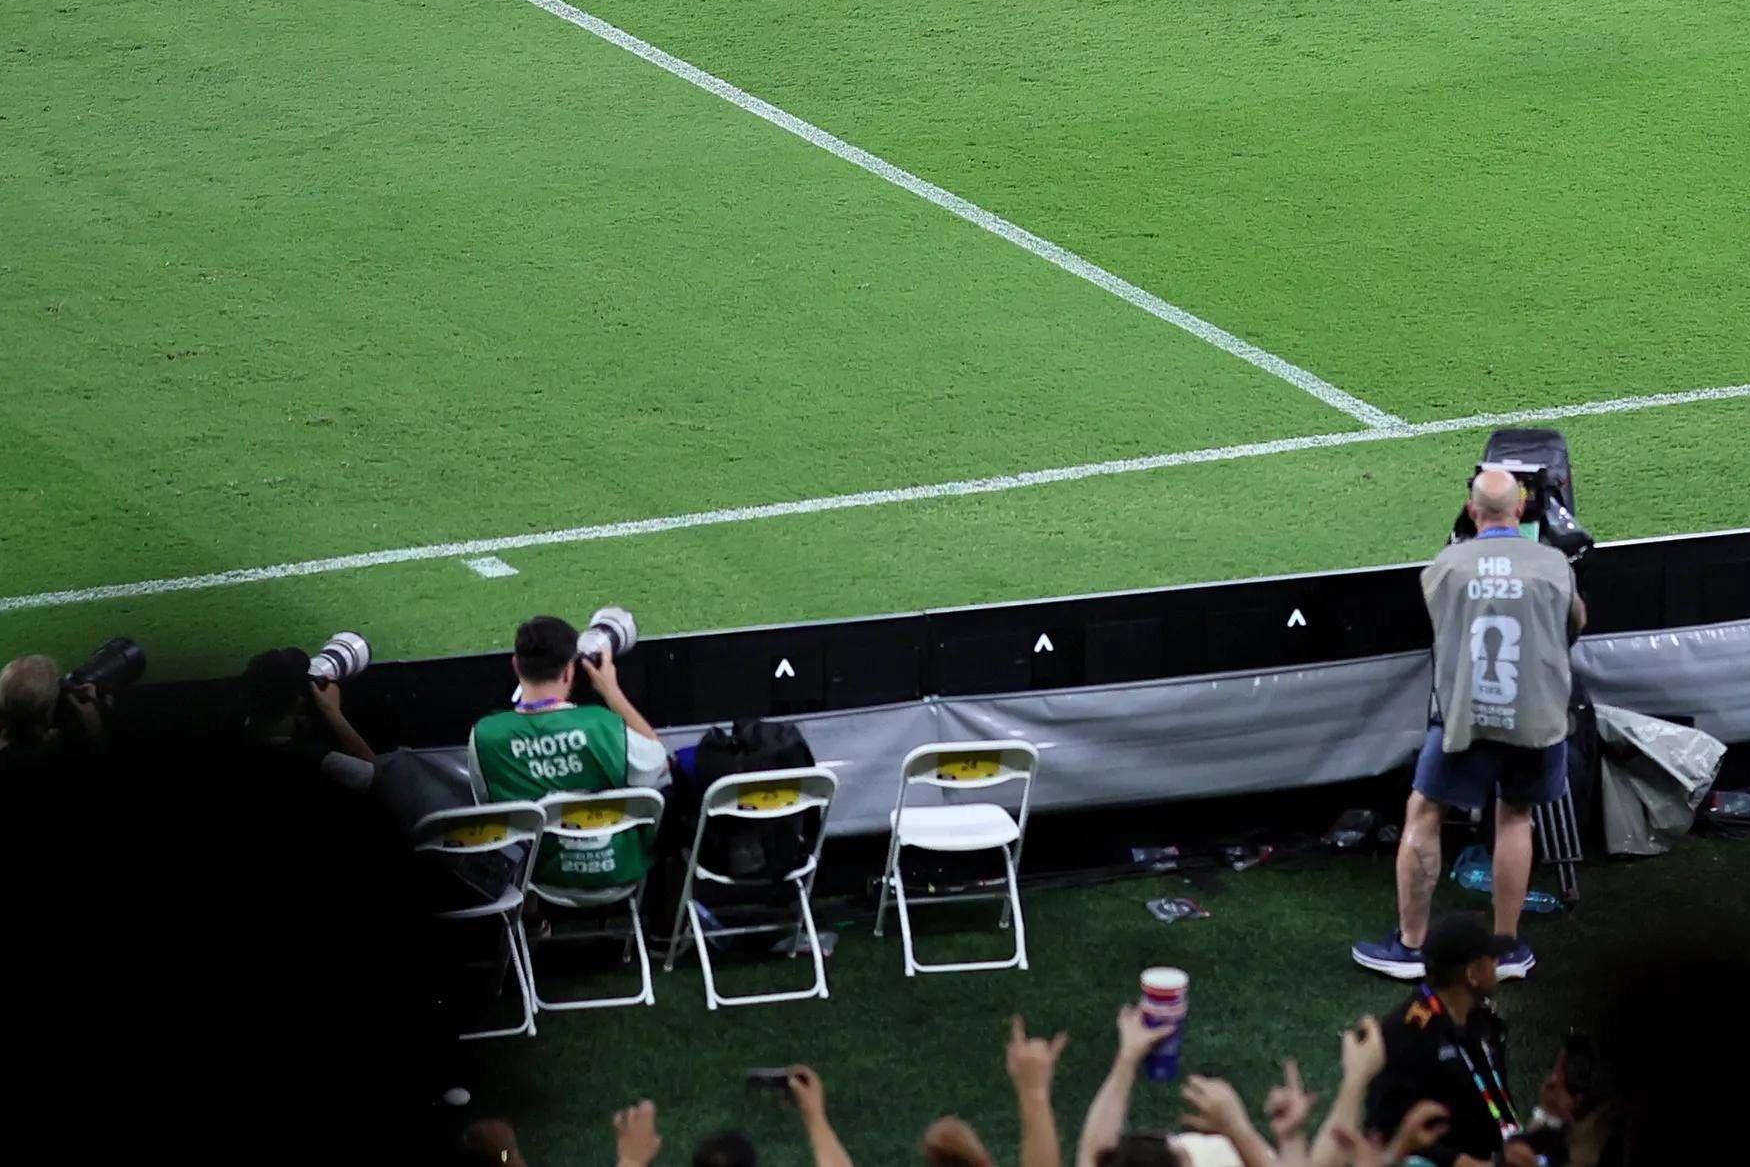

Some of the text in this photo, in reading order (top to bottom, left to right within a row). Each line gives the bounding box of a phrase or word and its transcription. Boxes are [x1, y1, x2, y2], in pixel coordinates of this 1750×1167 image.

[1476, 555, 1513, 577] HB
[1466, 578, 1524, 601] 0523
[510, 729, 588, 759] PHOTO
[528, 752, 584, 779] 0636
